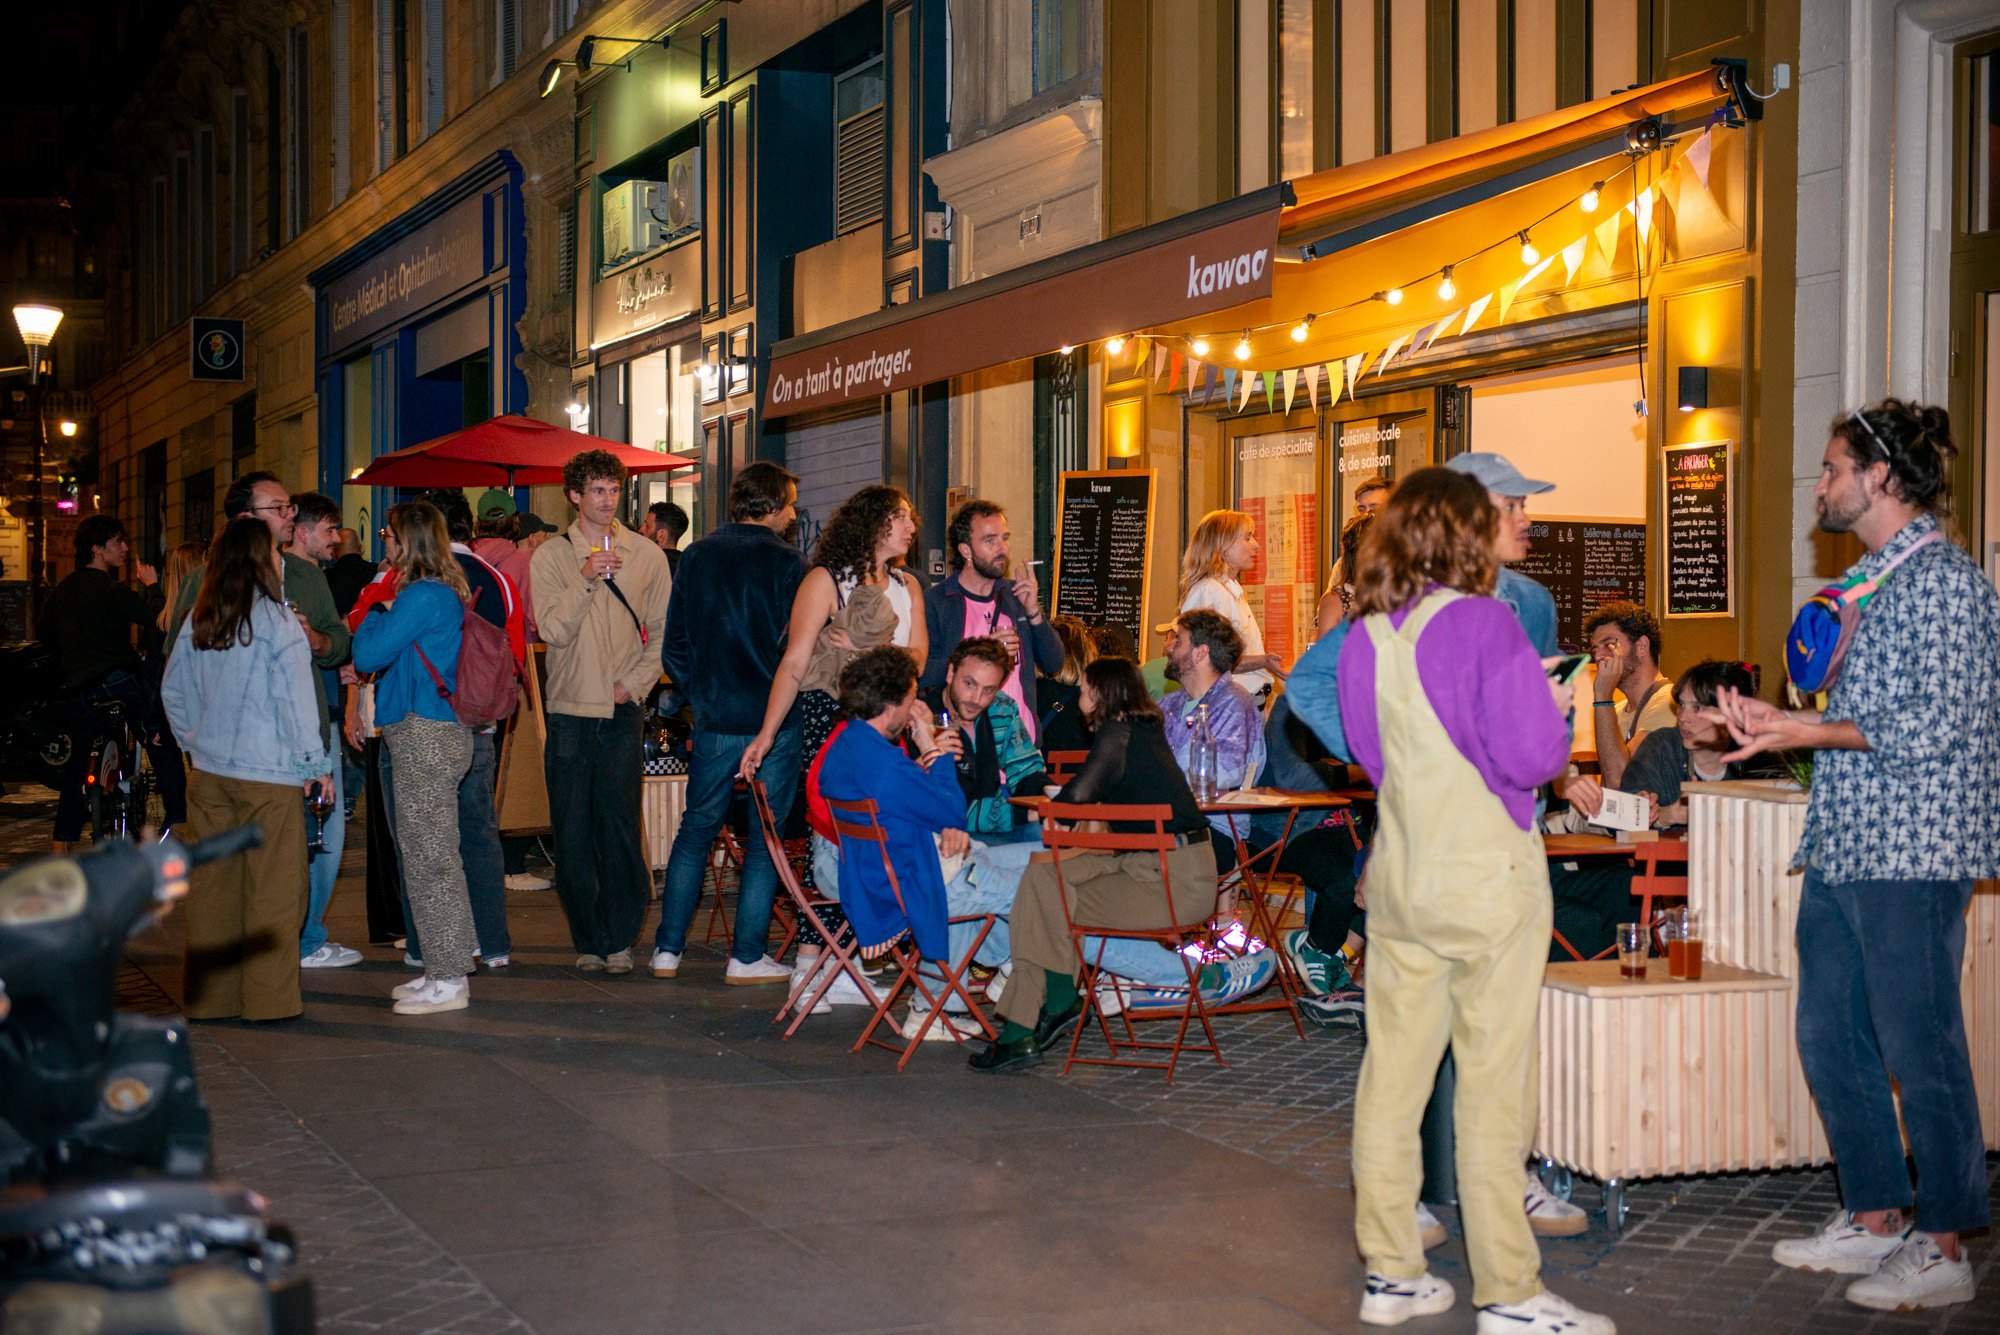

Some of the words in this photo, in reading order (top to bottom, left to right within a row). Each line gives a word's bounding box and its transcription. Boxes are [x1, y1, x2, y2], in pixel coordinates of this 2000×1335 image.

[1187, 248, 1268, 298] kawaa
[334, 297, 356, 332] Centre
[358, 270, 388, 321] Médical
[388, 269, 397, 302] et
[772, 374, 792, 404] On
[794, 377, 803, 400] a
[806, 362, 830, 397] tant
[832, 356, 842, 390] à
[844, 348, 912, 396] partager.
[1339, 429, 1370, 448] cuisine
[1373, 422, 1401, 442] locale
[1239, 444, 1256, 462] café
[1258, 442, 1270, 458] de
[1272, 436, 1314, 460] spécialité
[1684, 454, 1709, 470] PARTAGER
[1338, 458, 1346, 473] &
[1348, 456, 1360, 471] de
[1361, 452, 1391, 469] saison
[1528, 525, 1549, 538] ins
